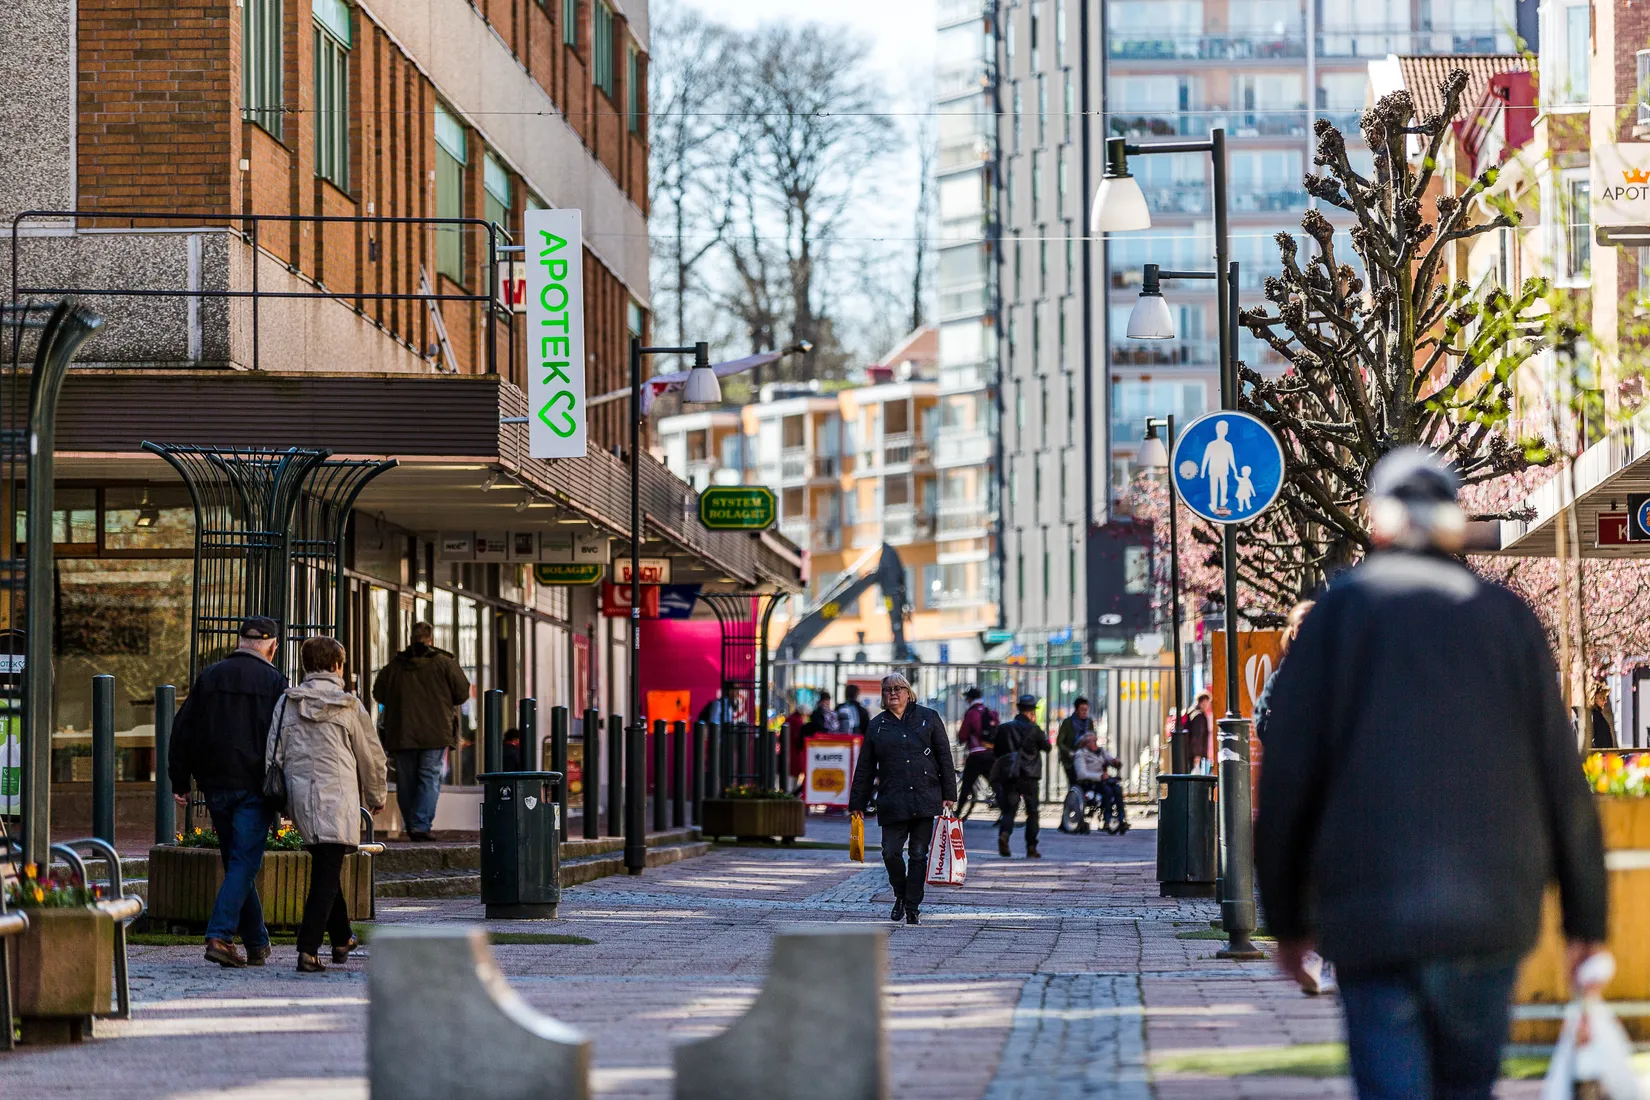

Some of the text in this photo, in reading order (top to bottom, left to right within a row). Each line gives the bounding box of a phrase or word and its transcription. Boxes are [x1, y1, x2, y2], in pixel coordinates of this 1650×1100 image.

[539, 229, 570, 385] APOTEK
[712, 497, 762, 507] SYSTEM
[709, 509, 766, 519] BOLAGET
[541, 565, 595, 574] BOLAGET
